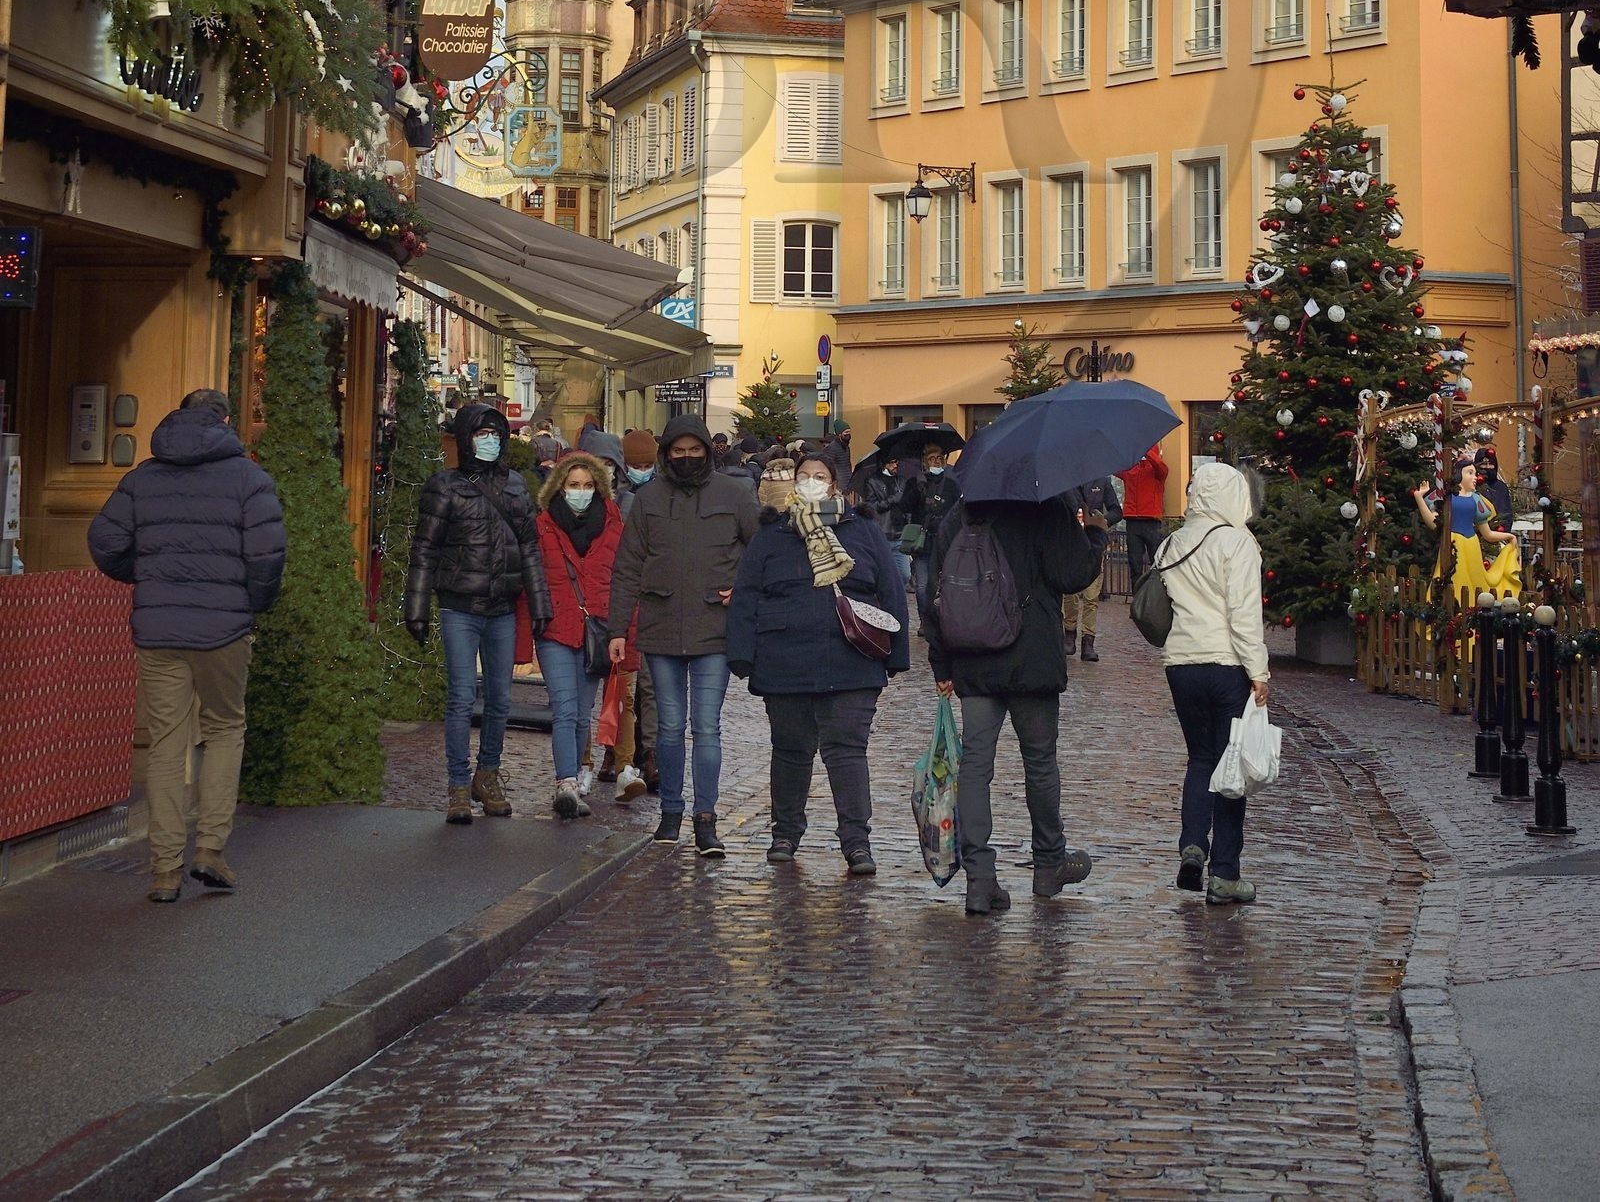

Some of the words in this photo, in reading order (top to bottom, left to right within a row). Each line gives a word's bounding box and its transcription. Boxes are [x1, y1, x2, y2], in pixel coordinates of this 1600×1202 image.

[445, 22, 489, 38] Patissier
[422, 38, 488, 54] Chocolatier
[1063, 345, 1134, 379] Caino
